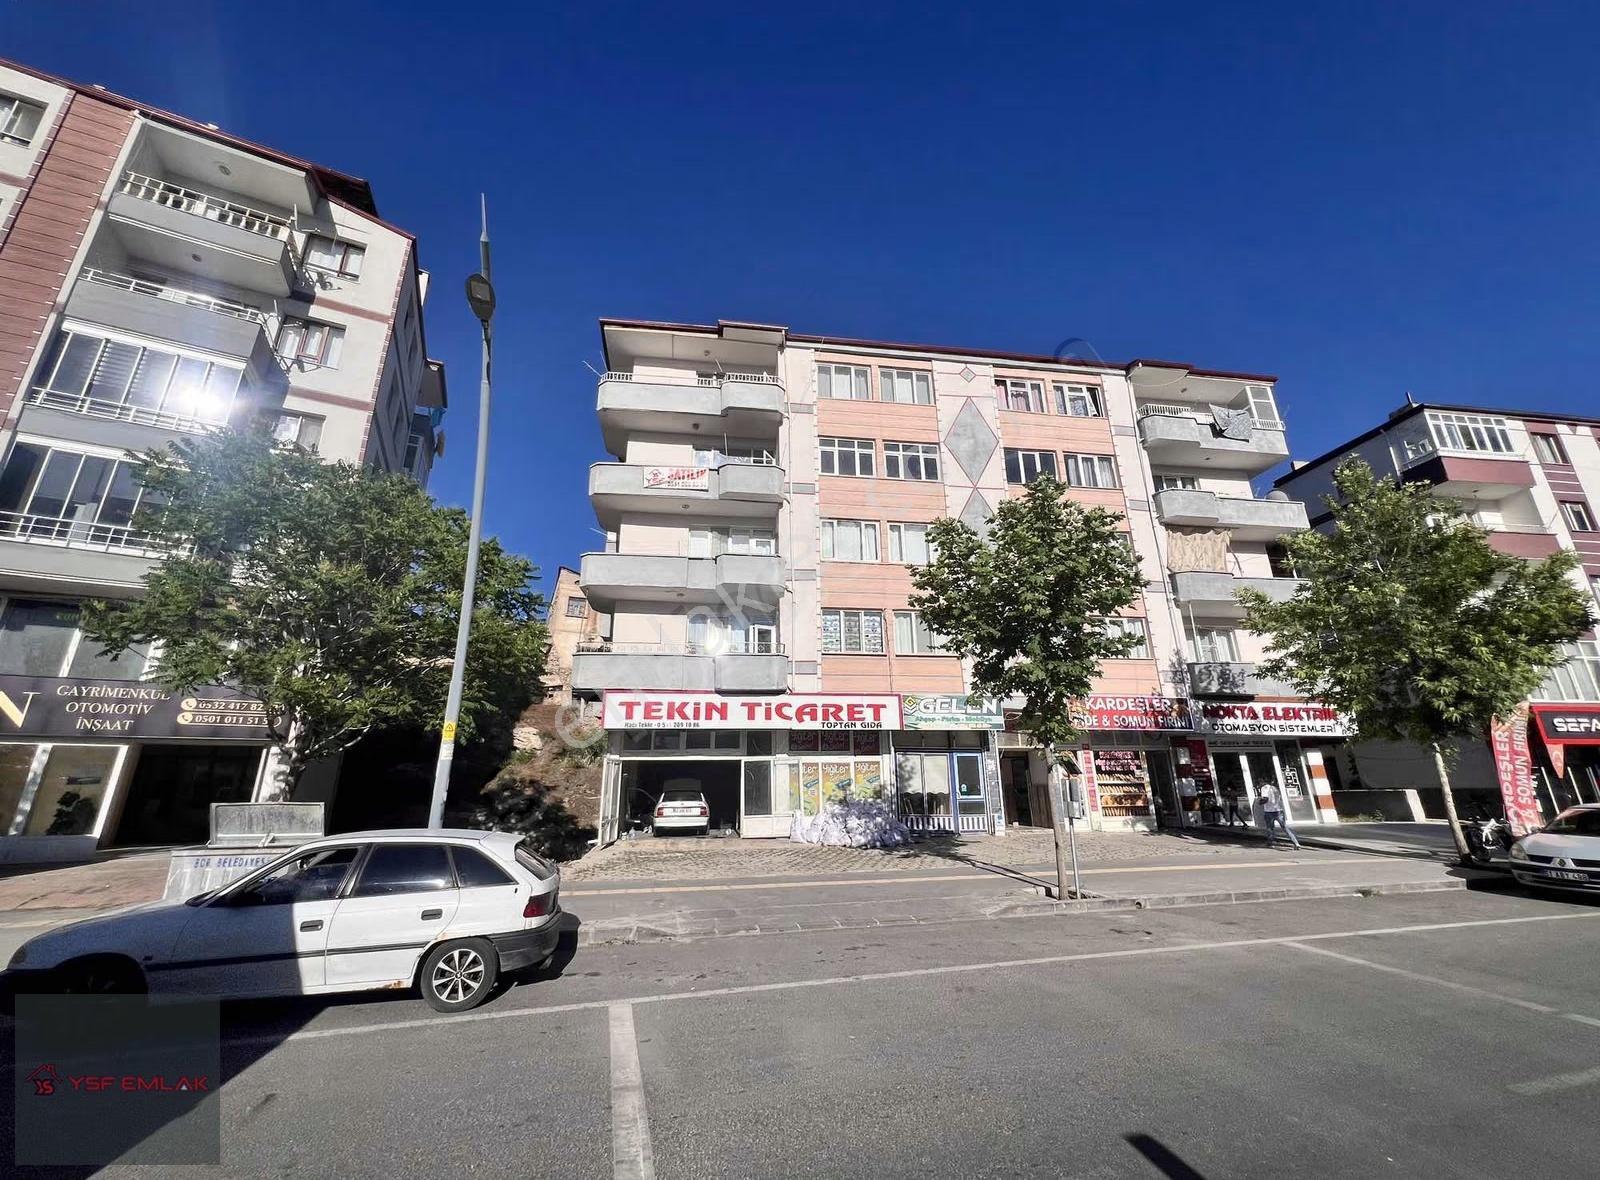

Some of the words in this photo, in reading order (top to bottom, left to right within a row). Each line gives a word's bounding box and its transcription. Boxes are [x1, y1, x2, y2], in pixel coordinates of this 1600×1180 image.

[66, 702, 153, 715] OTOMOTİV
[228, 702, 248, 711] 417
[250, 703, 264, 711] 82
[1085, 697, 1171, 714] KARDEŞLER
[76, 716, 134, 731] İNŞAAT
[195, 715, 221, 724] 0501
[224, 716, 243, 725] 011
[247, 717, 259, 725] 51
[1102, 715, 1111, 727] &
[1113, 715, 1155, 728] SOMUN
[1211, 723, 1277, 732] OTOMASYON
[1279, 722, 1337, 733] SİSTEMLERİ
